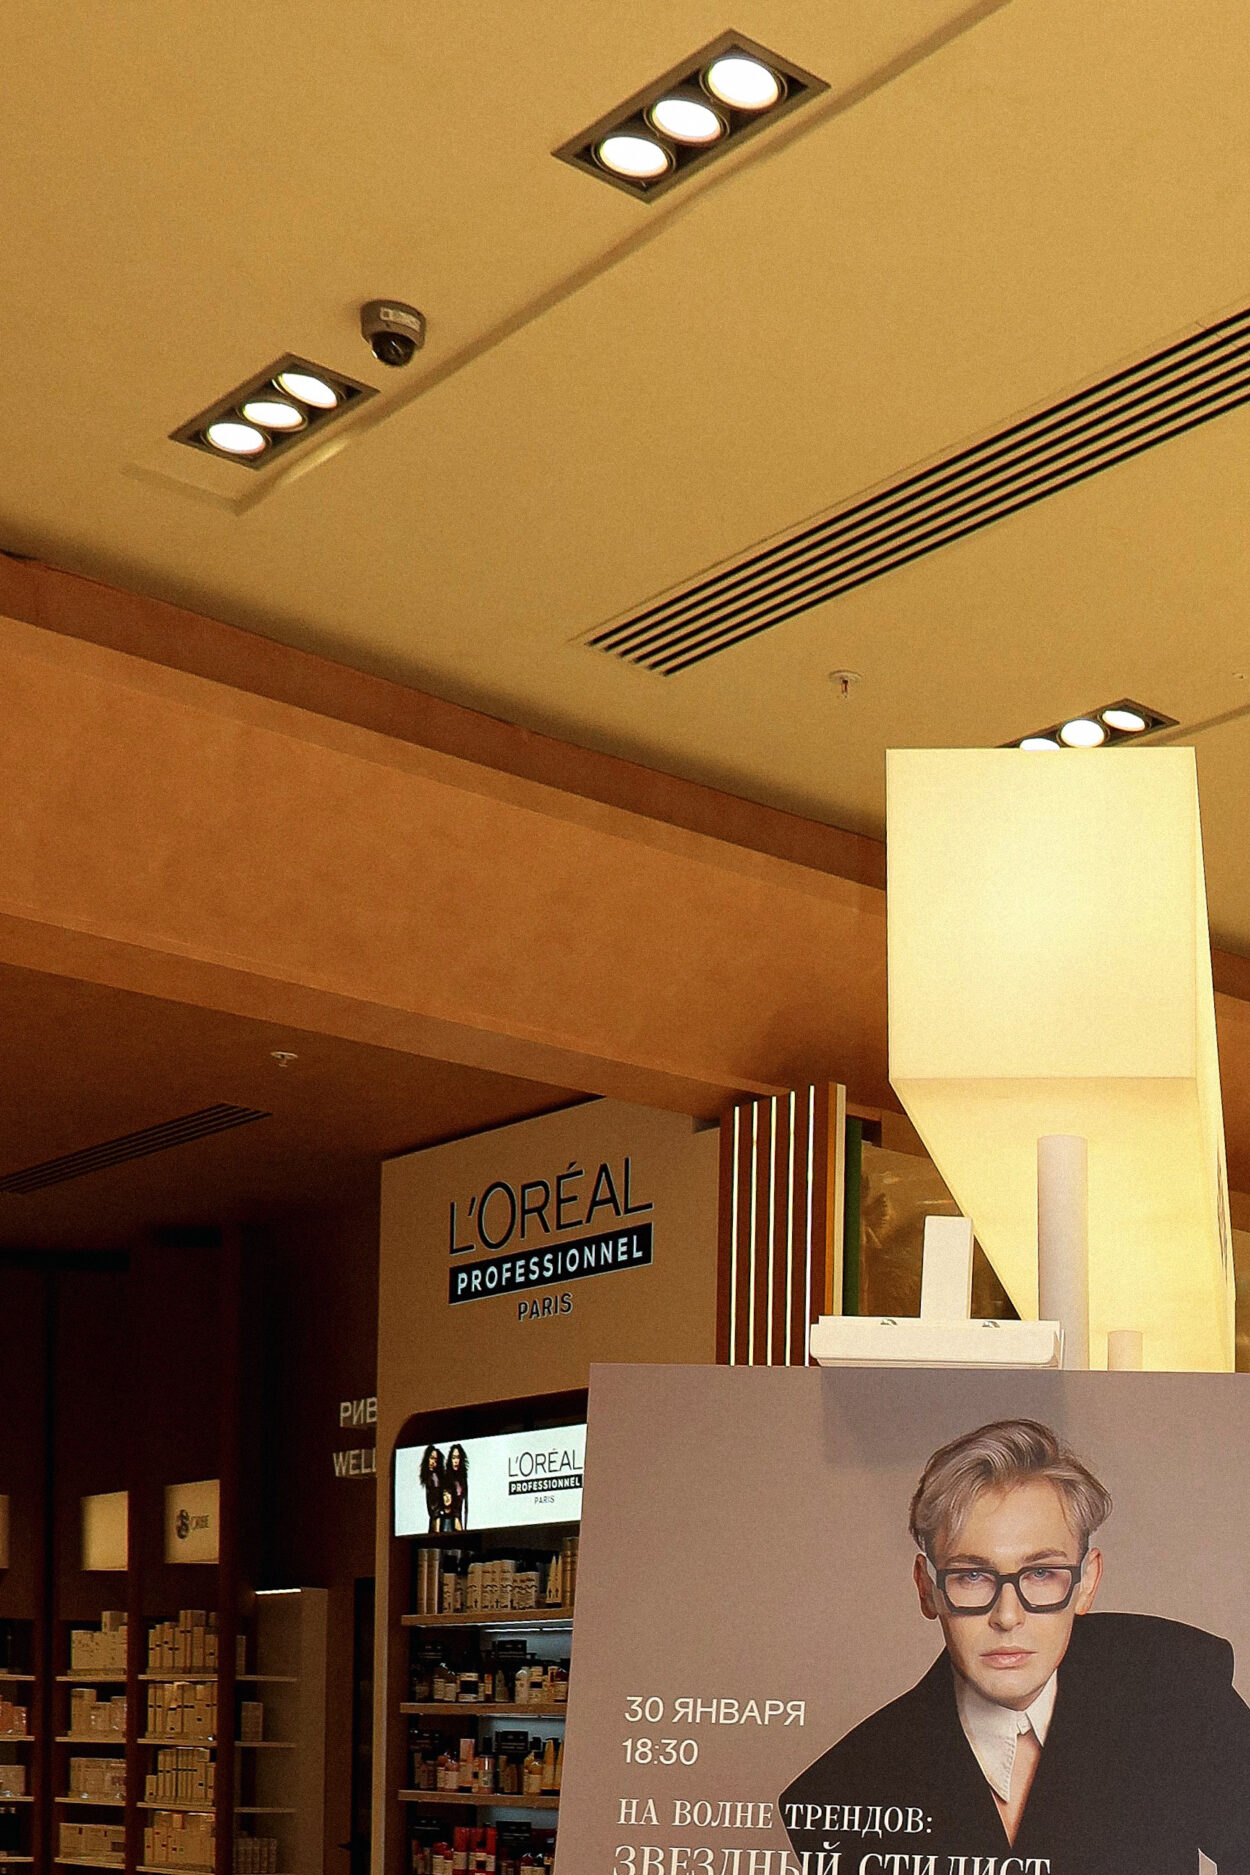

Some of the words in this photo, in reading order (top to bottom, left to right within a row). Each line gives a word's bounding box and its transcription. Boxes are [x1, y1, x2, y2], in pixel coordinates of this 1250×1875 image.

[450, 1157, 653, 1256] L'ORÉAL
[457, 1234, 643, 1295] PROFESSIONNEL
[517, 1292, 573, 1322] PARIS
[508, 1448, 583, 1477] L'ORÉAL
[510, 1477, 580, 1493] PROFESSIONNEL
[624, 1696, 664, 1723] 30
[672, 1698, 806, 1726] ЯНВАРЯ
[622, 1738, 699, 1766] 18:30
[617, 1797, 660, 1826] НА
[672, 1800, 774, 1830] ВОЛНЕ
[784, 1803, 933, 1838] ТРЕНДОВ:
